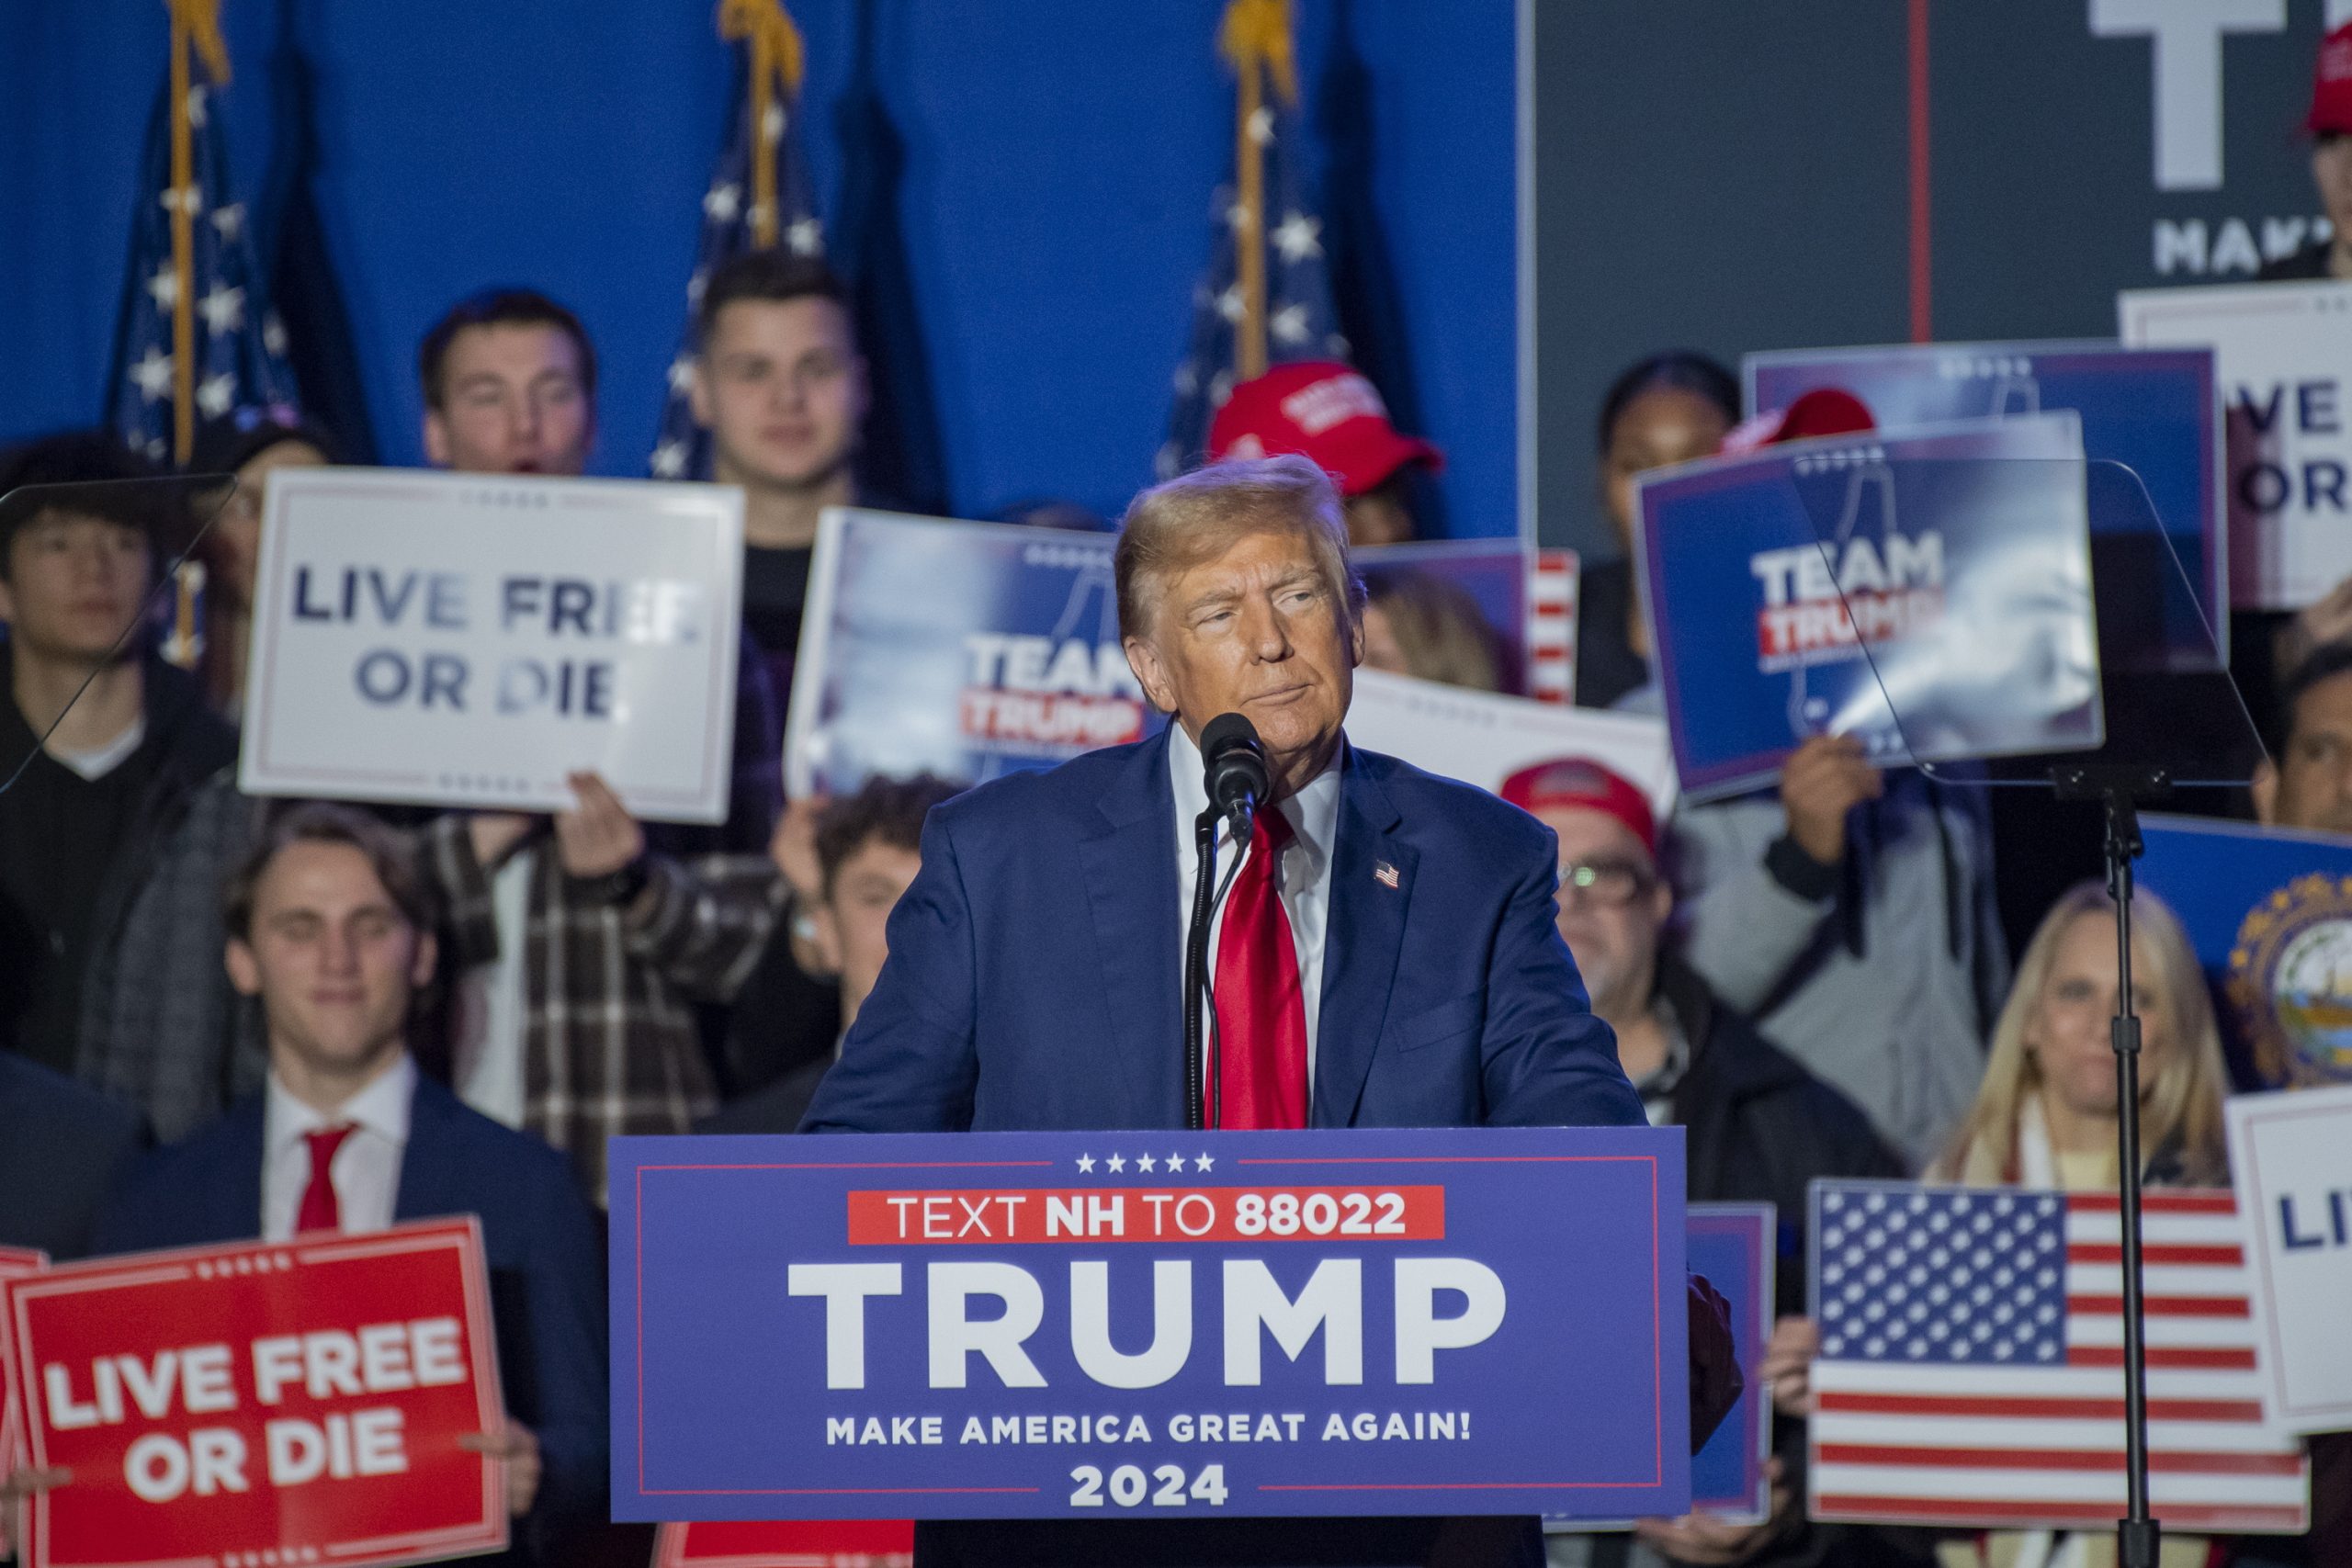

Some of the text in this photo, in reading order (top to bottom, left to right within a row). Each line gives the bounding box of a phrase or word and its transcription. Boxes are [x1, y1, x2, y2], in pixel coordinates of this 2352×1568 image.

[2154, 217, 2335, 274] MAK
[2236, 381, 2340, 434] VE
[2236, 460, 2350, 514] OR
[1750, 530, 1944, 604] TEAM
[291, 564, 469, 631] LIVE
[354, 648, 628, 723] OR DIE
[888, 1192, 1406, 1238] TEXT NH TO 88022
[2280, 1191, 2352, 1251] LI
[787, 1257, 1507, 1390] TRUMP
[43, 1315, 467, 1430] LIVE FREE
[123, 1406, 408, 1504] OR DIE
[826, 1412, 1470, 1446] MAKE AMERICA GREAT AGAIN!
[1069, 1464, 1228, 1507] 2024
